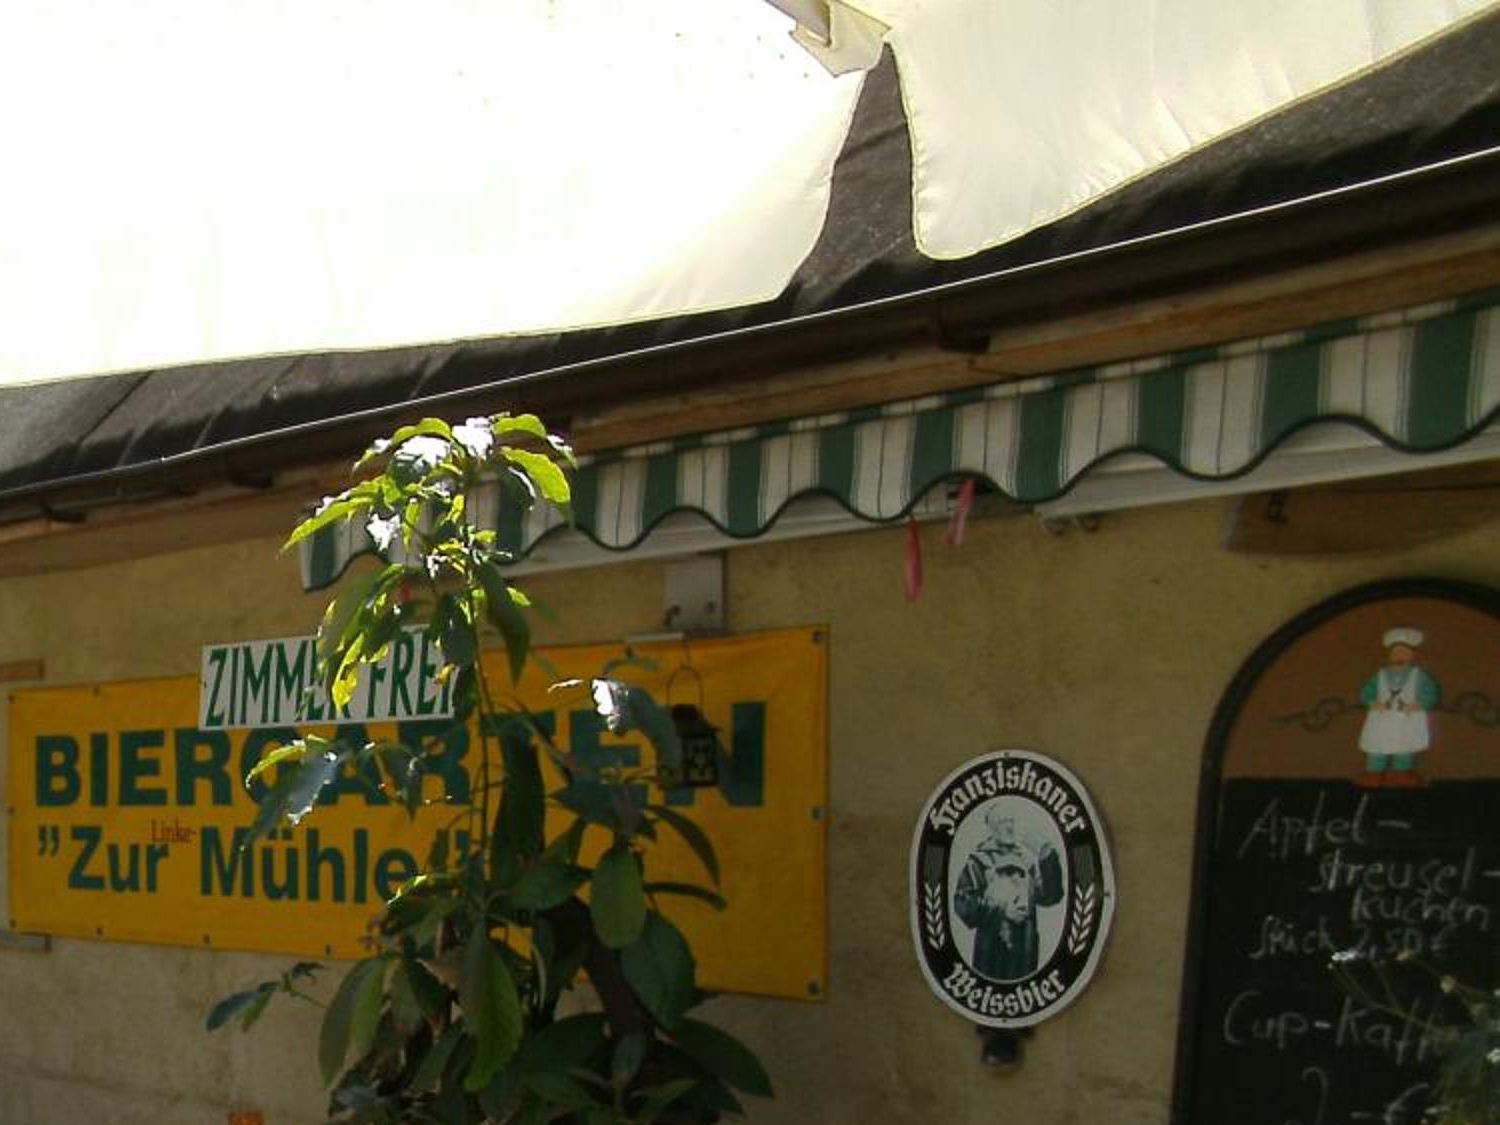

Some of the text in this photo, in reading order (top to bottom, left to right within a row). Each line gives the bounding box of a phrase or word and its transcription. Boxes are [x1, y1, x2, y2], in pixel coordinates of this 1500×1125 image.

[206, 631, 350, 727] ZIMME
[929, 761, 1086, 835] Franziskaner
[943, 962, 1066, 1017] Weissbier
